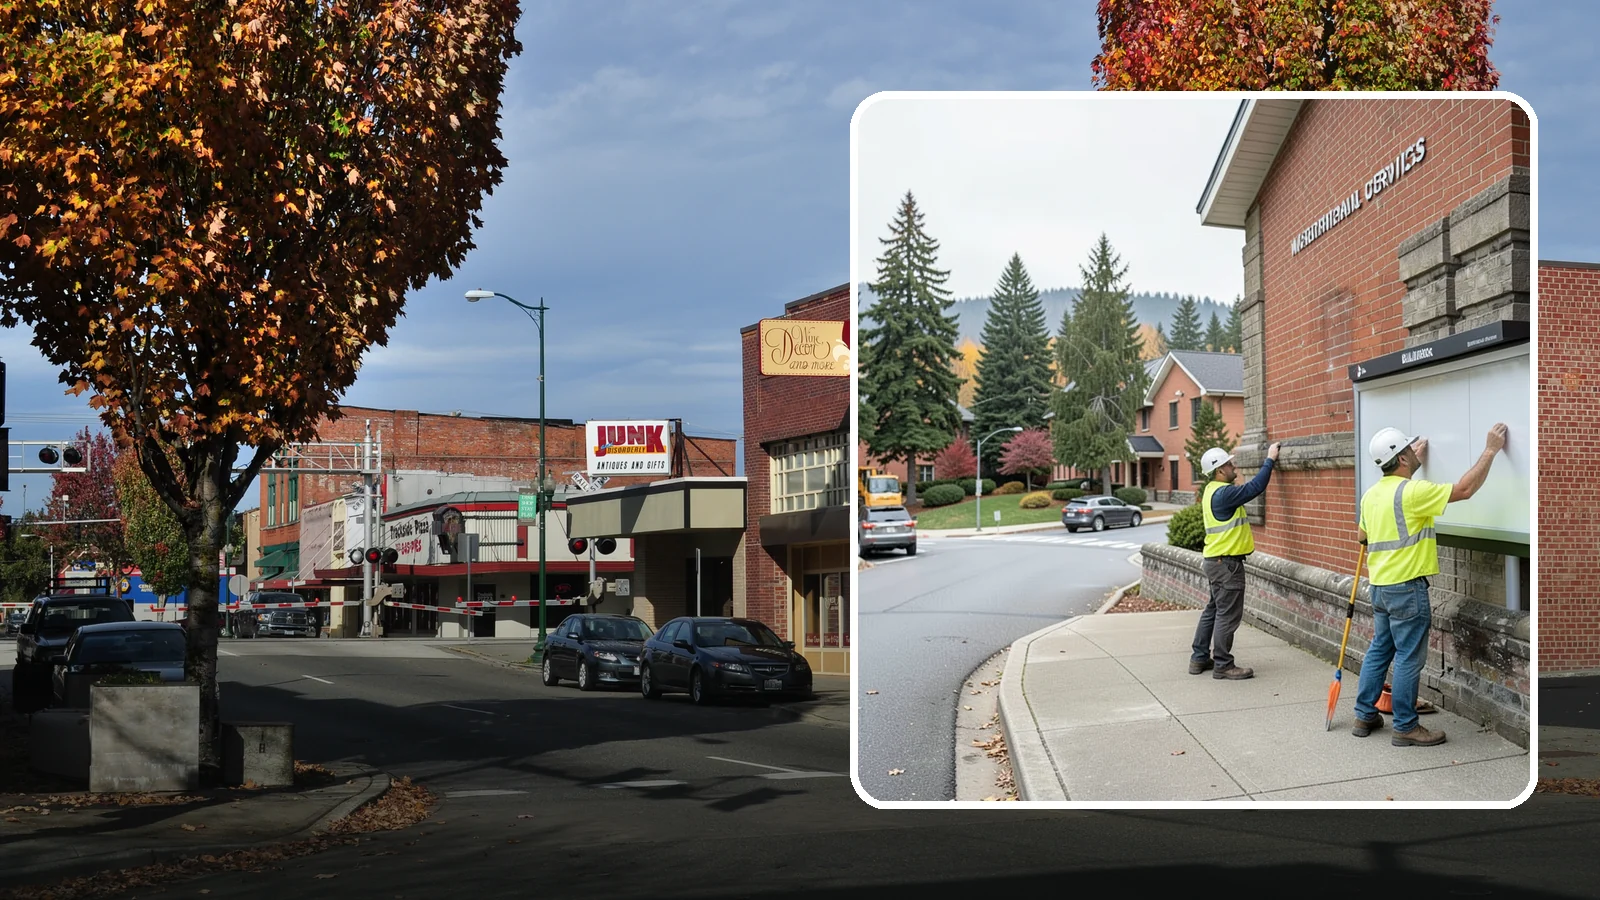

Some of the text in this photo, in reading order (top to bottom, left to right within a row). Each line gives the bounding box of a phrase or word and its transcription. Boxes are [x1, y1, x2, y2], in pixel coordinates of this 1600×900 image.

[765, 327, 831, 366] Decor
[595, 425, 664, 457] JUNK
[607, 445, 646, 454] DISORDERLY
[597, 460, 665, 470] ANTIQUES AND GIFTS
[390, 519, 429, 539] Trackside Pizza
